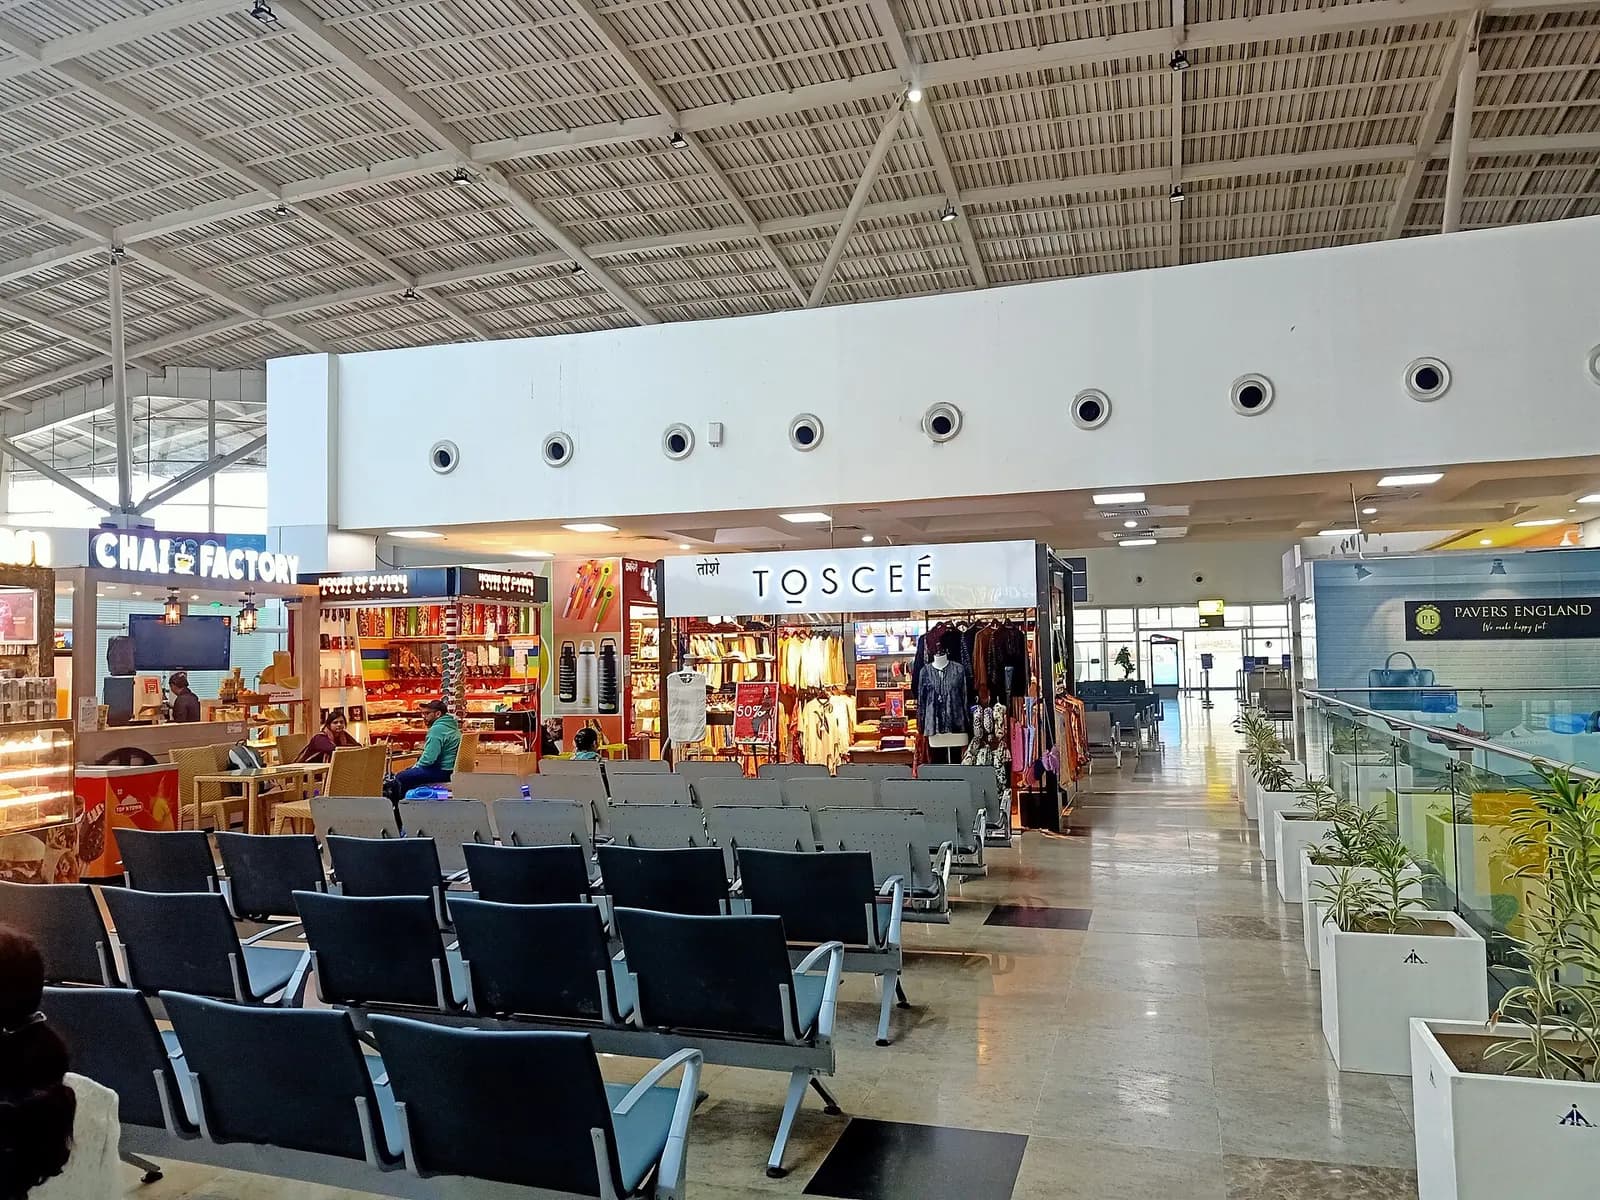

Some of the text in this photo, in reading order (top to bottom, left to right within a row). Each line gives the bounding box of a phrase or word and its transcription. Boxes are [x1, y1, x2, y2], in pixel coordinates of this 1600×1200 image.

[95, 532, 299, 584] CHAI FACTORY
[319, 576, 353, 595] HOUSE
[354, 576, 368, 594] OF
[502, 575, 510, 592] OF
[1454, 604, 1592, 618] PAVERS ENGLAND
[1513, 621, 1532, 633] happy
[736, 704, 763, 719] 50%
